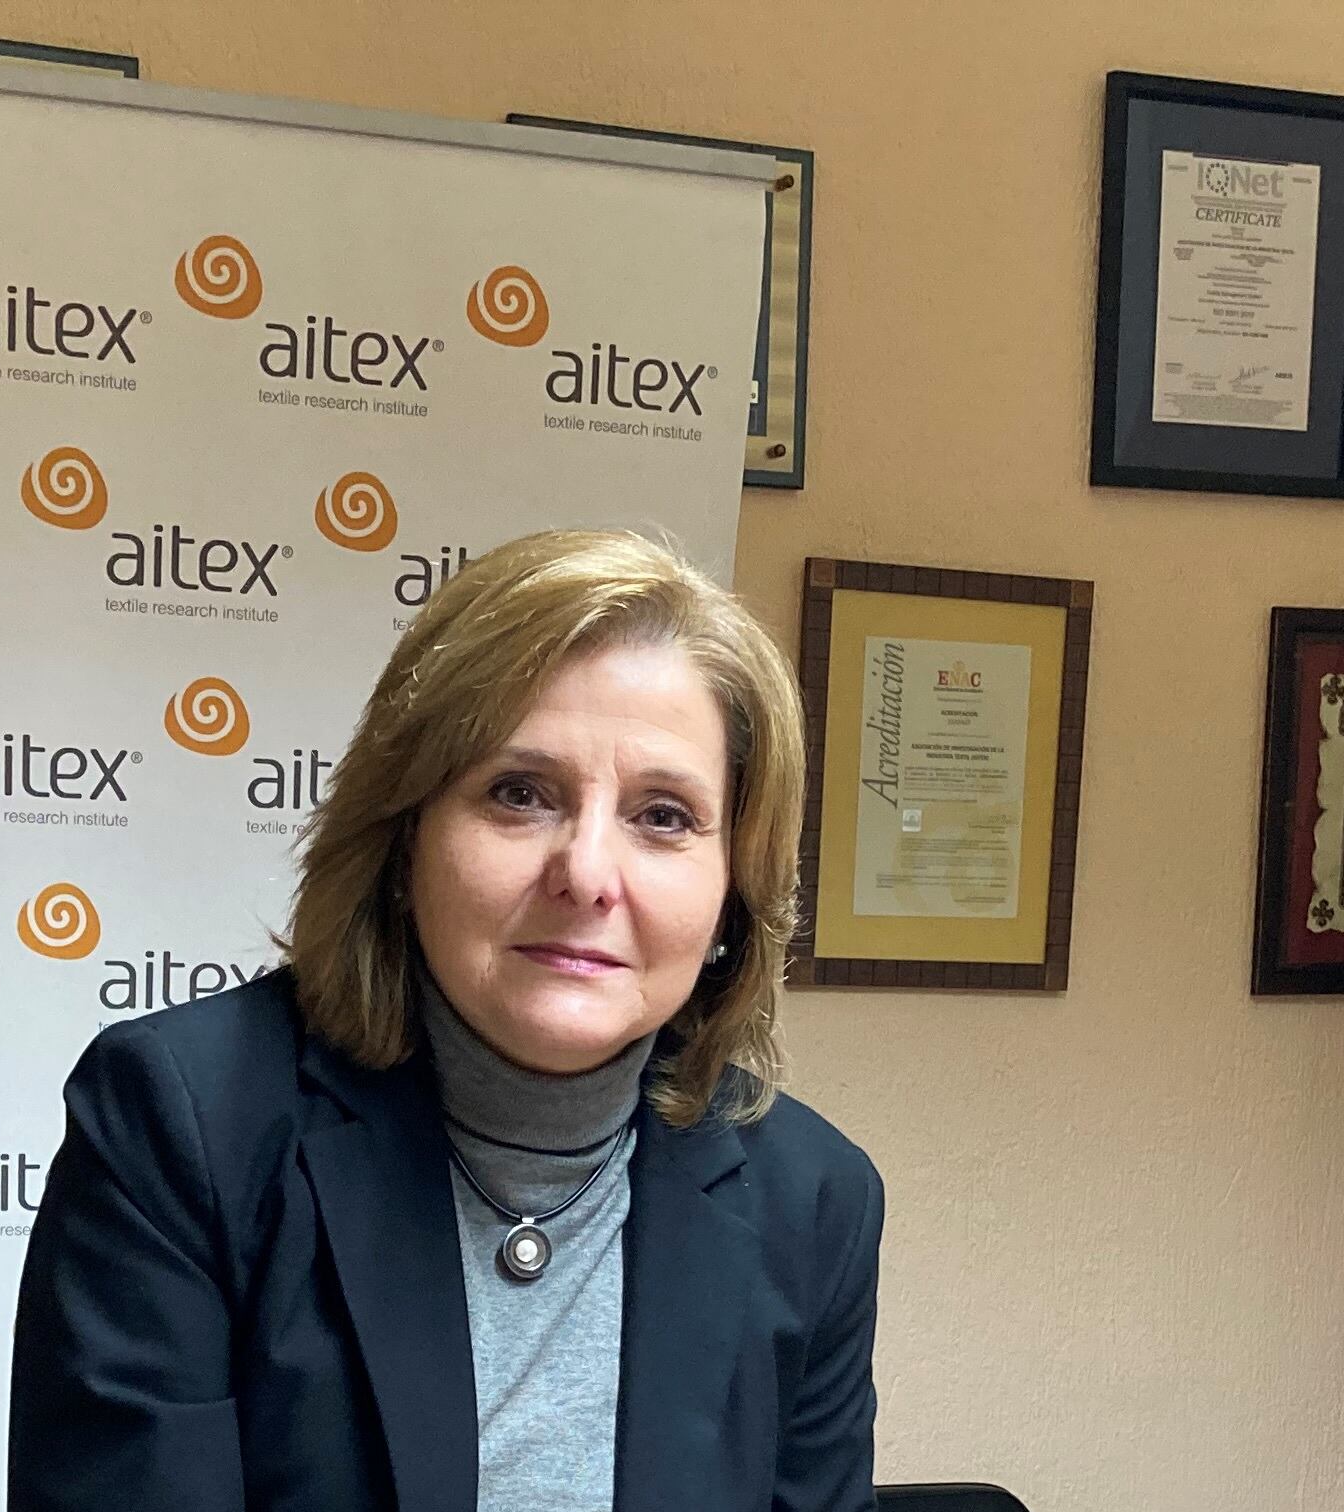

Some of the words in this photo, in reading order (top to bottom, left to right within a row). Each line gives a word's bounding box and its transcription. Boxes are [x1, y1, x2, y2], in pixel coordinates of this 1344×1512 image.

[1196, 207, 1282, 228] CERTIFICATE
[7, 365, 75, 386] research
[79, 373, 137, 391] institute
[258, 388, 301, 406] textile
[304, 391, 369, 412] research
[372, 398, 429, 417] institute
[544, 414, 585, 432] textile
[588, 418, 649, 437] research
[653, 424, 703, 442] institute
[105, 597, 149, 616] textile
[152, 600, 218, 619] research
[222, 604, 279, 622] institute
[937, 670, 981, 688] ENAC
[862, 642, 906, 809] Acreditación
[248, 749, 333, 810] ait
[3, 808, 69, 826] research
[72, 811, 129, 827] institute
[246, 821, 288, 835] textile
[0, 1225, 32, 1237] rese
